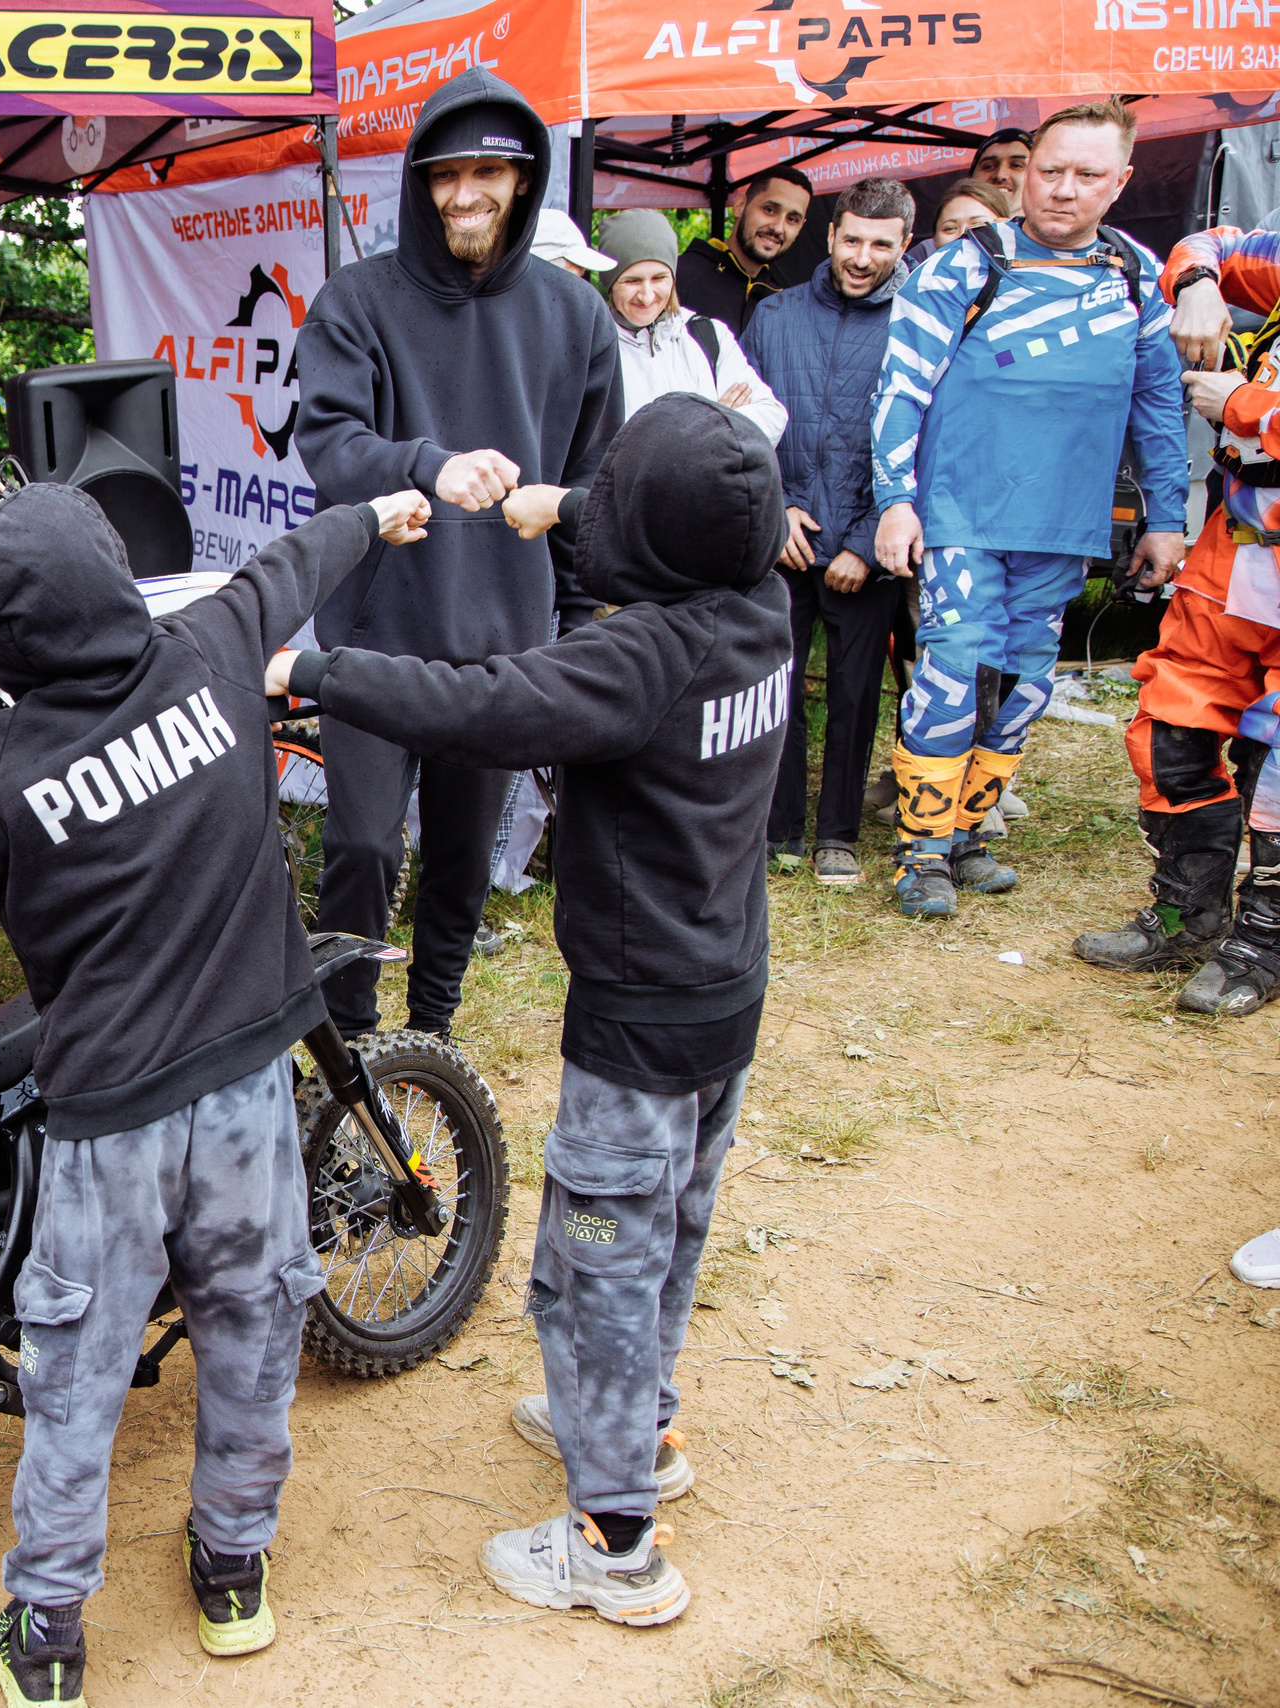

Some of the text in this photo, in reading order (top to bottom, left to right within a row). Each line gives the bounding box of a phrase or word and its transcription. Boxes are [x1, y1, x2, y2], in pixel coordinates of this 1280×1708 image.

[643, 12, 983, 60] ALFI PARTS
[1153, 45, 1234, 72] СВЕЧИ
[172, 193, 368, 242] ЧЕСТНЫЕ ЗАПЧАТИ
[22, 686, 236, 845] РОМАН
